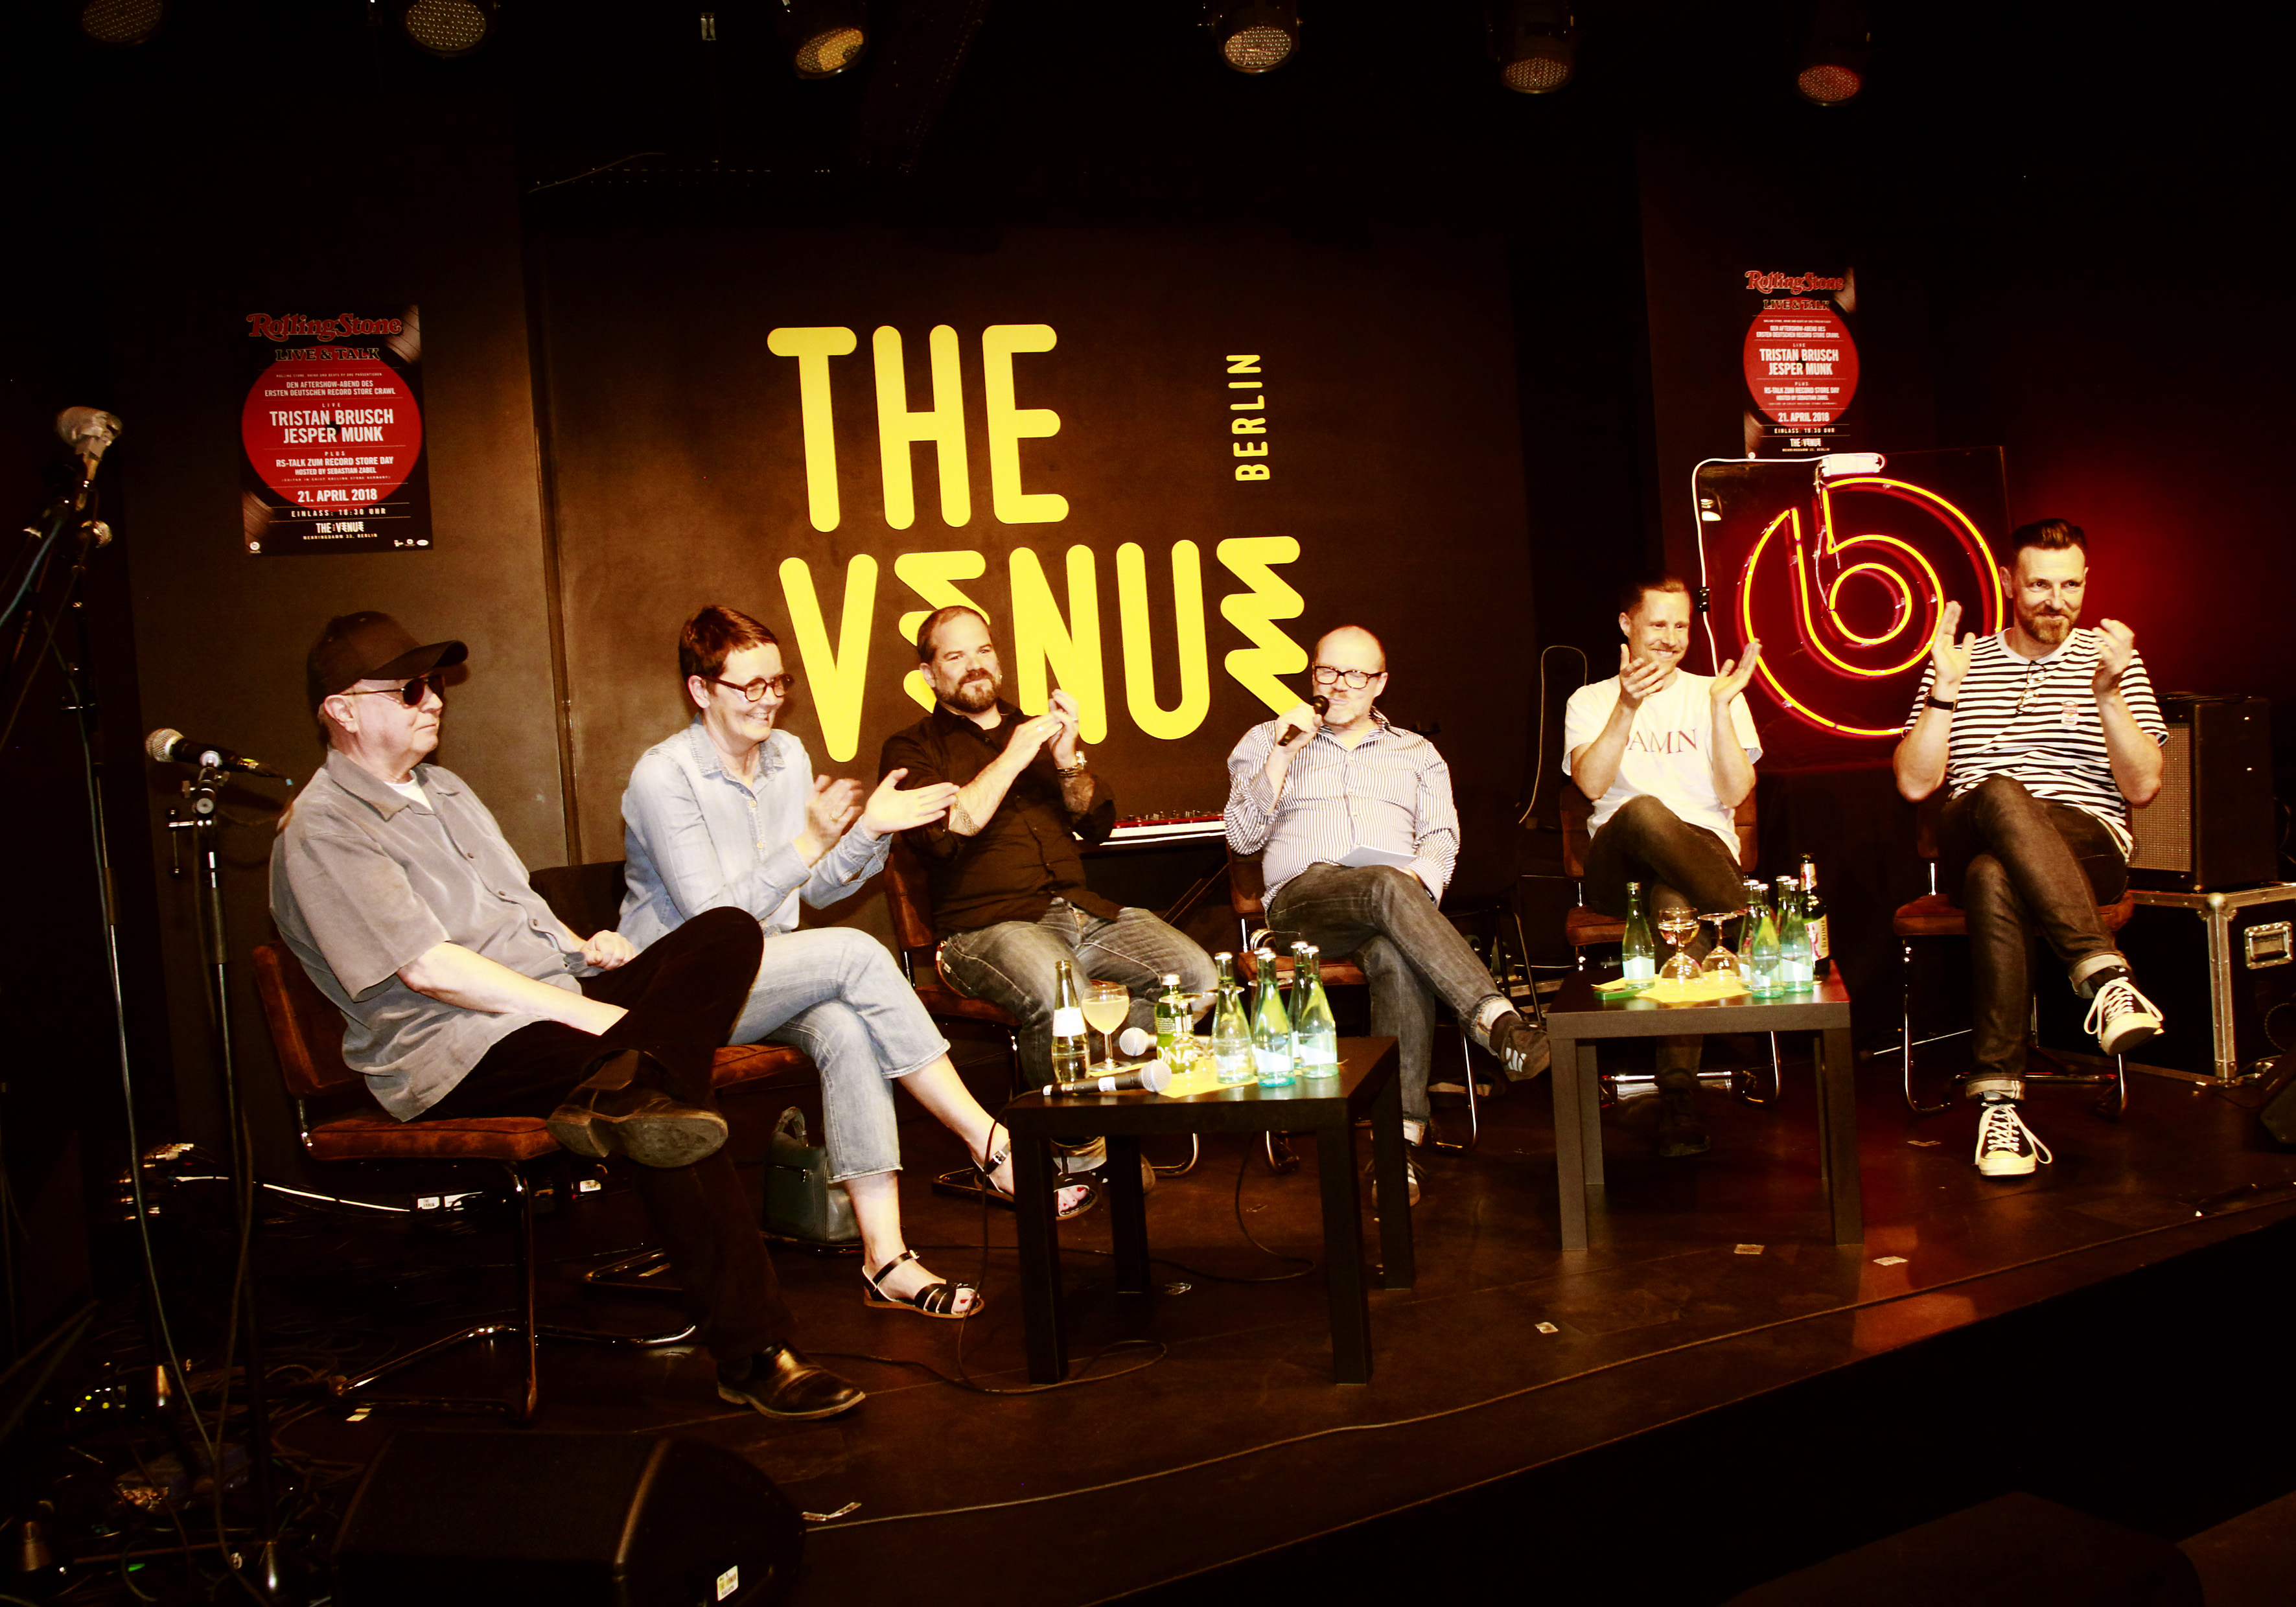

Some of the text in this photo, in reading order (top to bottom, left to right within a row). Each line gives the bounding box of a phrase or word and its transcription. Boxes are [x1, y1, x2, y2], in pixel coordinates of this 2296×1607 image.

[1763, 299, 1830, 310] LIVE & TALK
[275, 347, 381, 361] LIVE & TALK
[1759, 349, 1839, 362] TRISTAN BRUSCH
[1768, 362, 1833, 375] JESPER MUNK
[270, 409, 394, 426] TRISTAN BRUSCH
[1227, 354, 1270, 481] BERLIN
[1778, 412, 1829, 422] 21. APRIL 2018
[283, 426, 384, 444] JESPER MUNK
[767, 324, 1069, 532] THE
[276, 456, 394, 467] RS-TALK ZUM RECORD STORE DAY
[297, 488, 377, 502] 21. APRIL 2018
[316, 522, 332, 533] THE
[336, 521, 364, 533] VENUE
[1626, 728, 1697, 754] AMN
